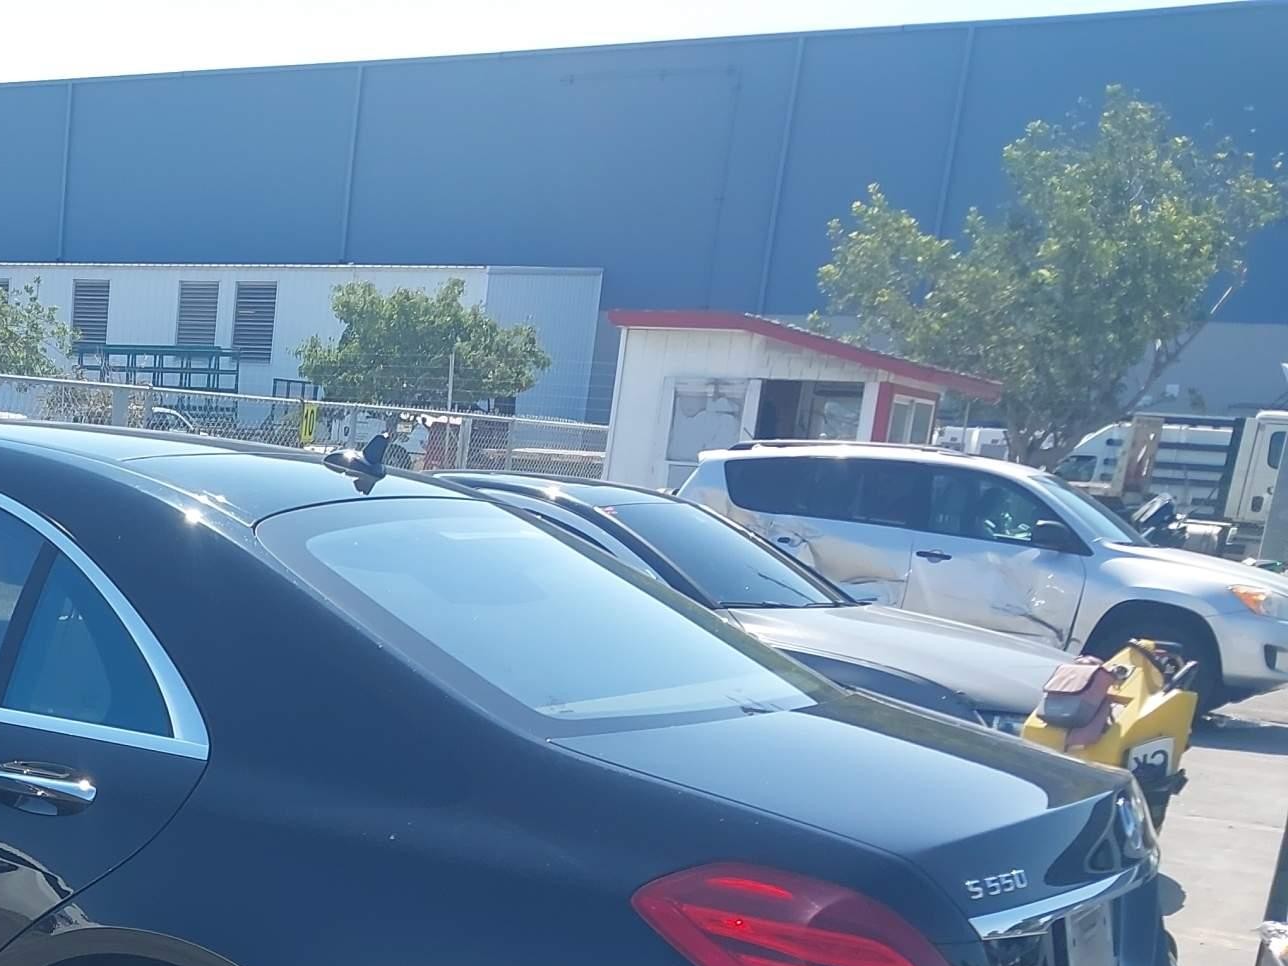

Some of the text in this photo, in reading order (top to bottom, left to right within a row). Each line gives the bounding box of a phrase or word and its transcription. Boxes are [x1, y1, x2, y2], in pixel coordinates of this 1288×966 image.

[304, 409, 315, 436] 10
[965, 869, 1028, 900] S 550
